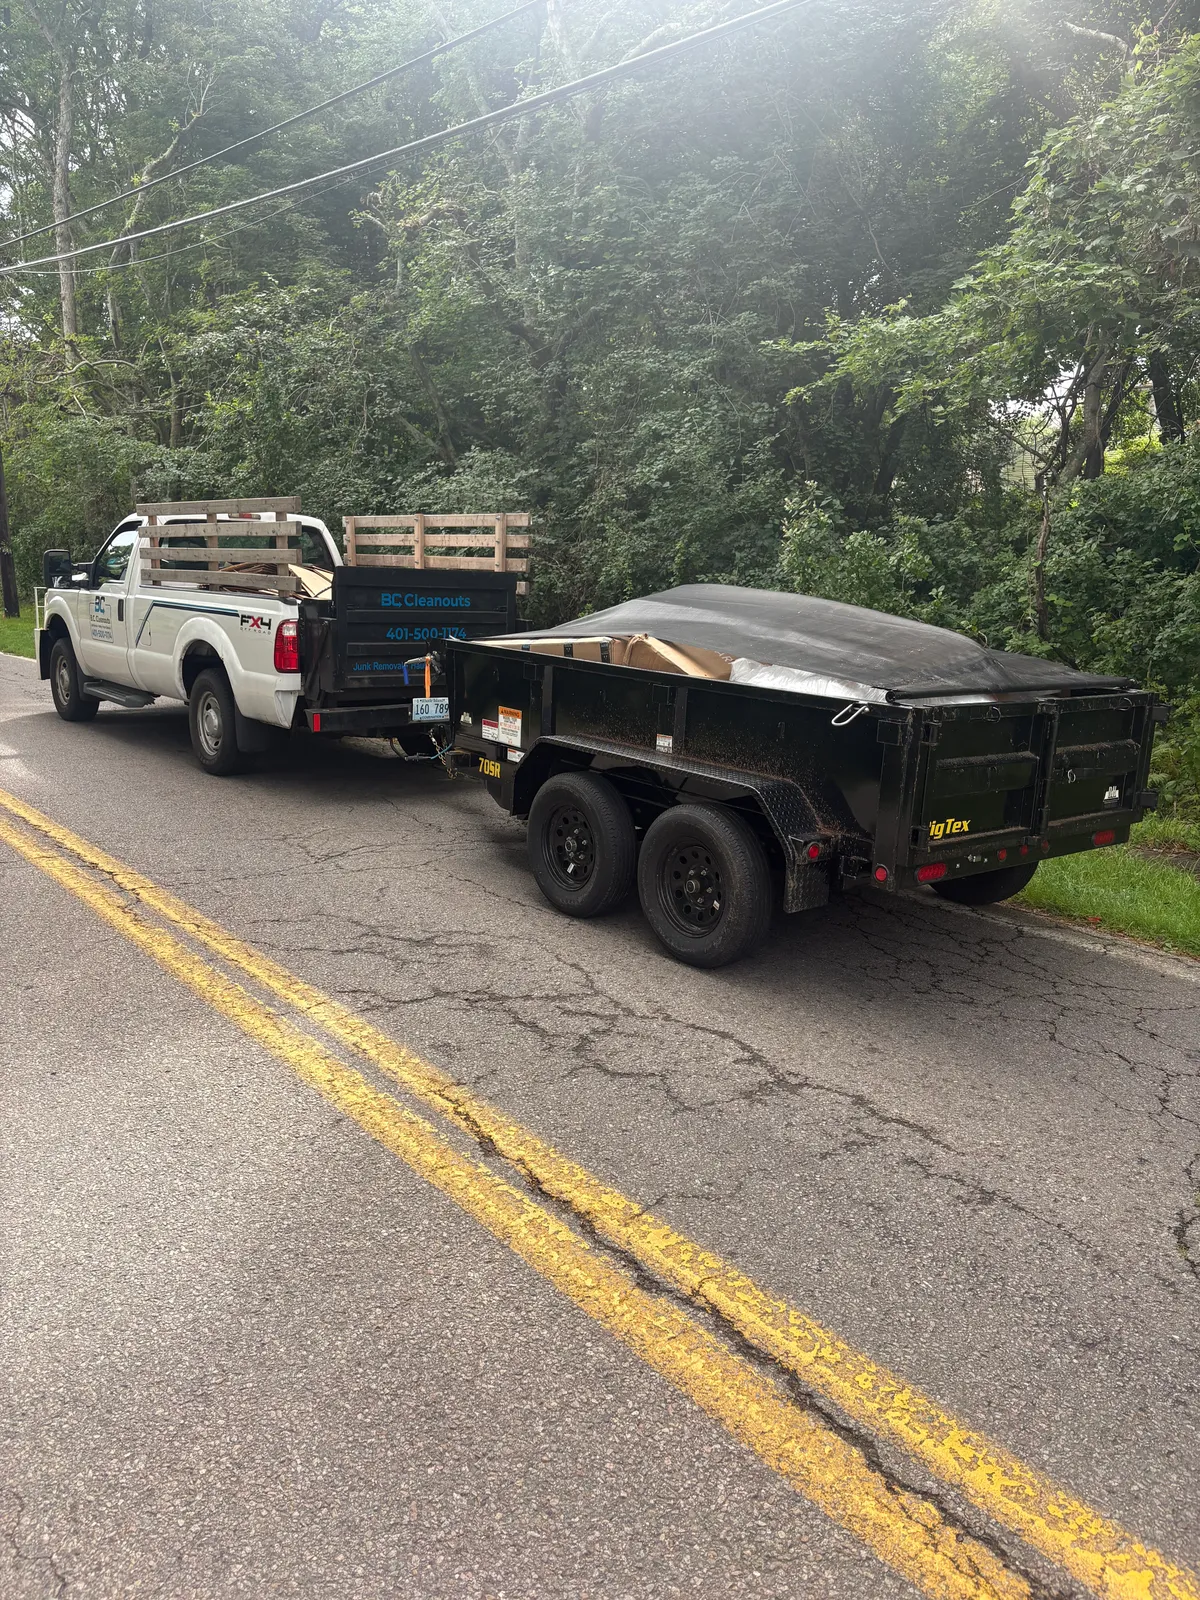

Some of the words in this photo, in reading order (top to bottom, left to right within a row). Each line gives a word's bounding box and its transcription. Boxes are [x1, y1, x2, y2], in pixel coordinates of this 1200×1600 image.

[381, 593, 402, 607] BC
[403, 593, 471, 607] Cleanouts
[240, 614, 272, 630] FX4
[386, 627, 467, 640] 401-500-1174
[353, 662, 371, 671] Junk
[415, 703, 430, 715] 160
[434, 703, 449, 714] 789
[929, 818, 971, 840] igTex
